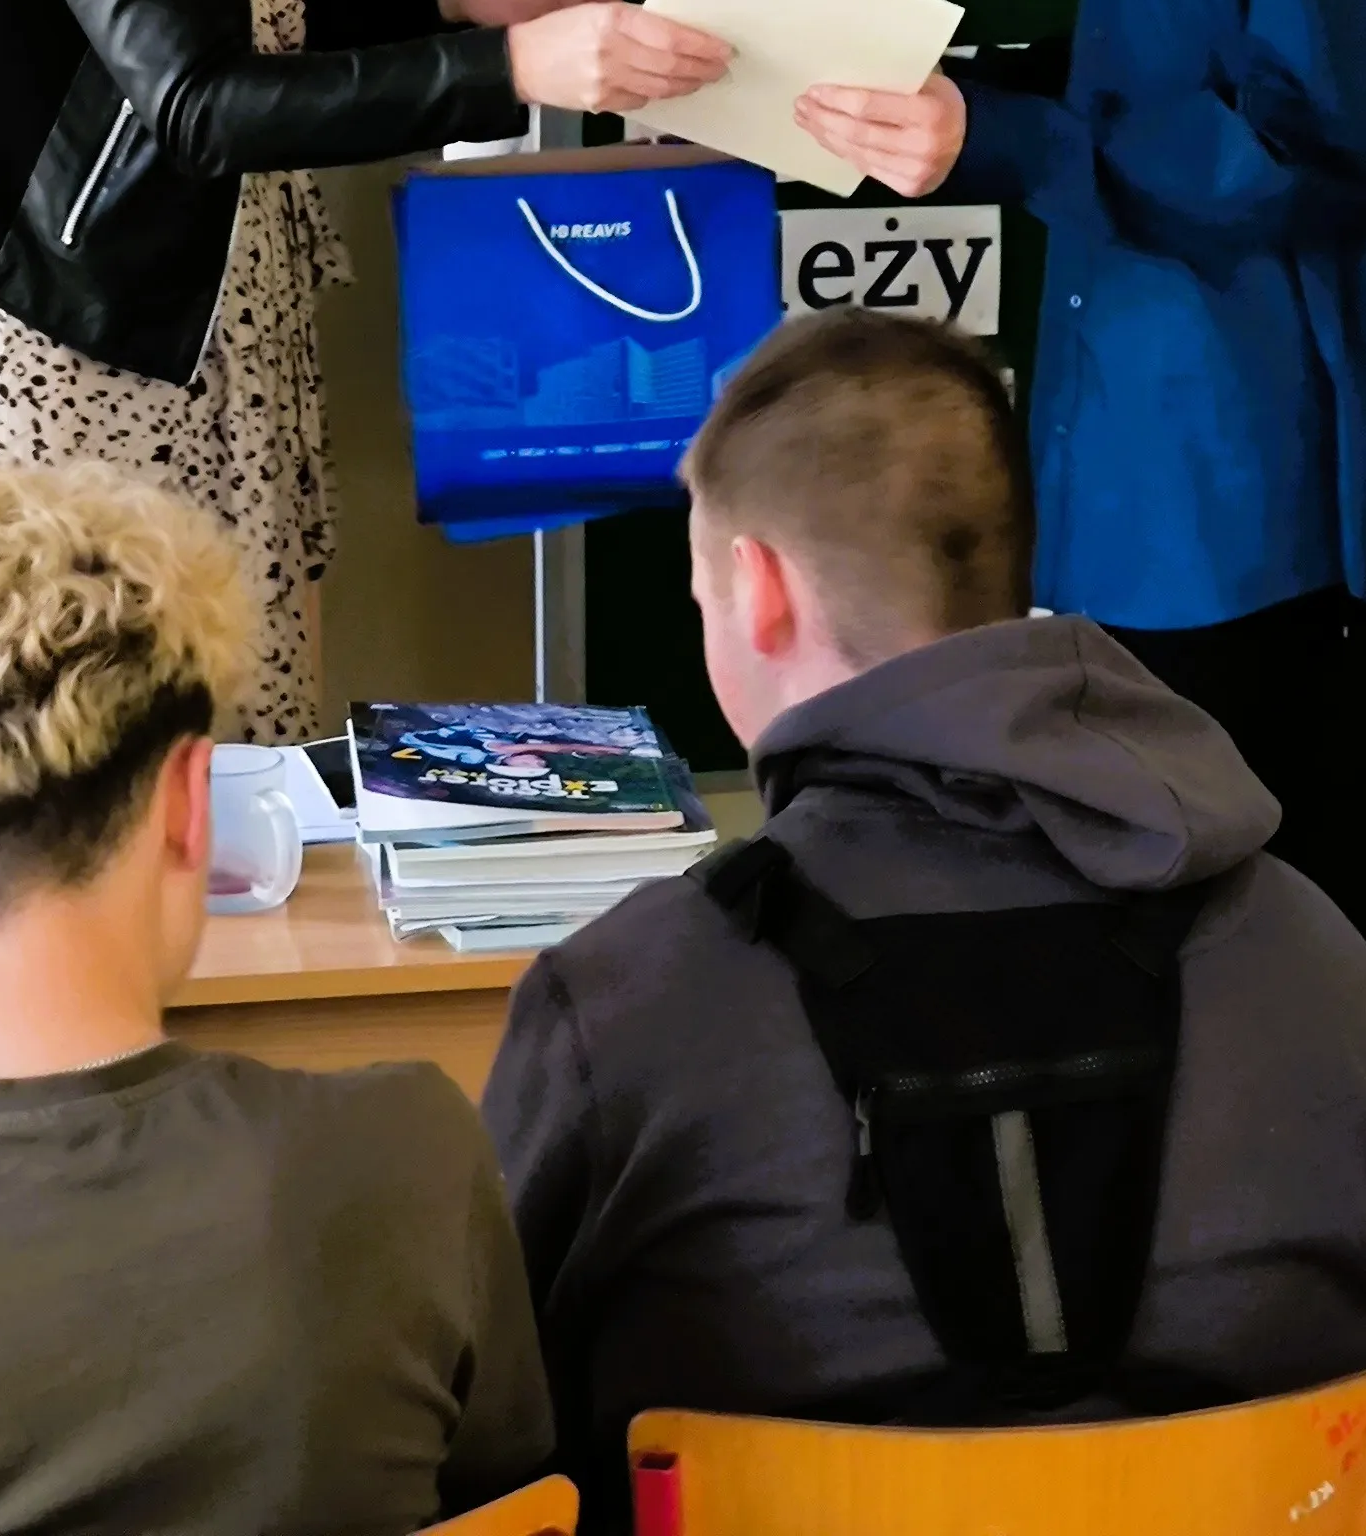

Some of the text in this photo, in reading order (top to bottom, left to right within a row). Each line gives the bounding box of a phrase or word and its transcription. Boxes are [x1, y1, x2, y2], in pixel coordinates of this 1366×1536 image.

[570, 221, 632, 239] REAVIS
[781, 217, 993, 321] eży
[418, 771, 619, 794] Explorer
